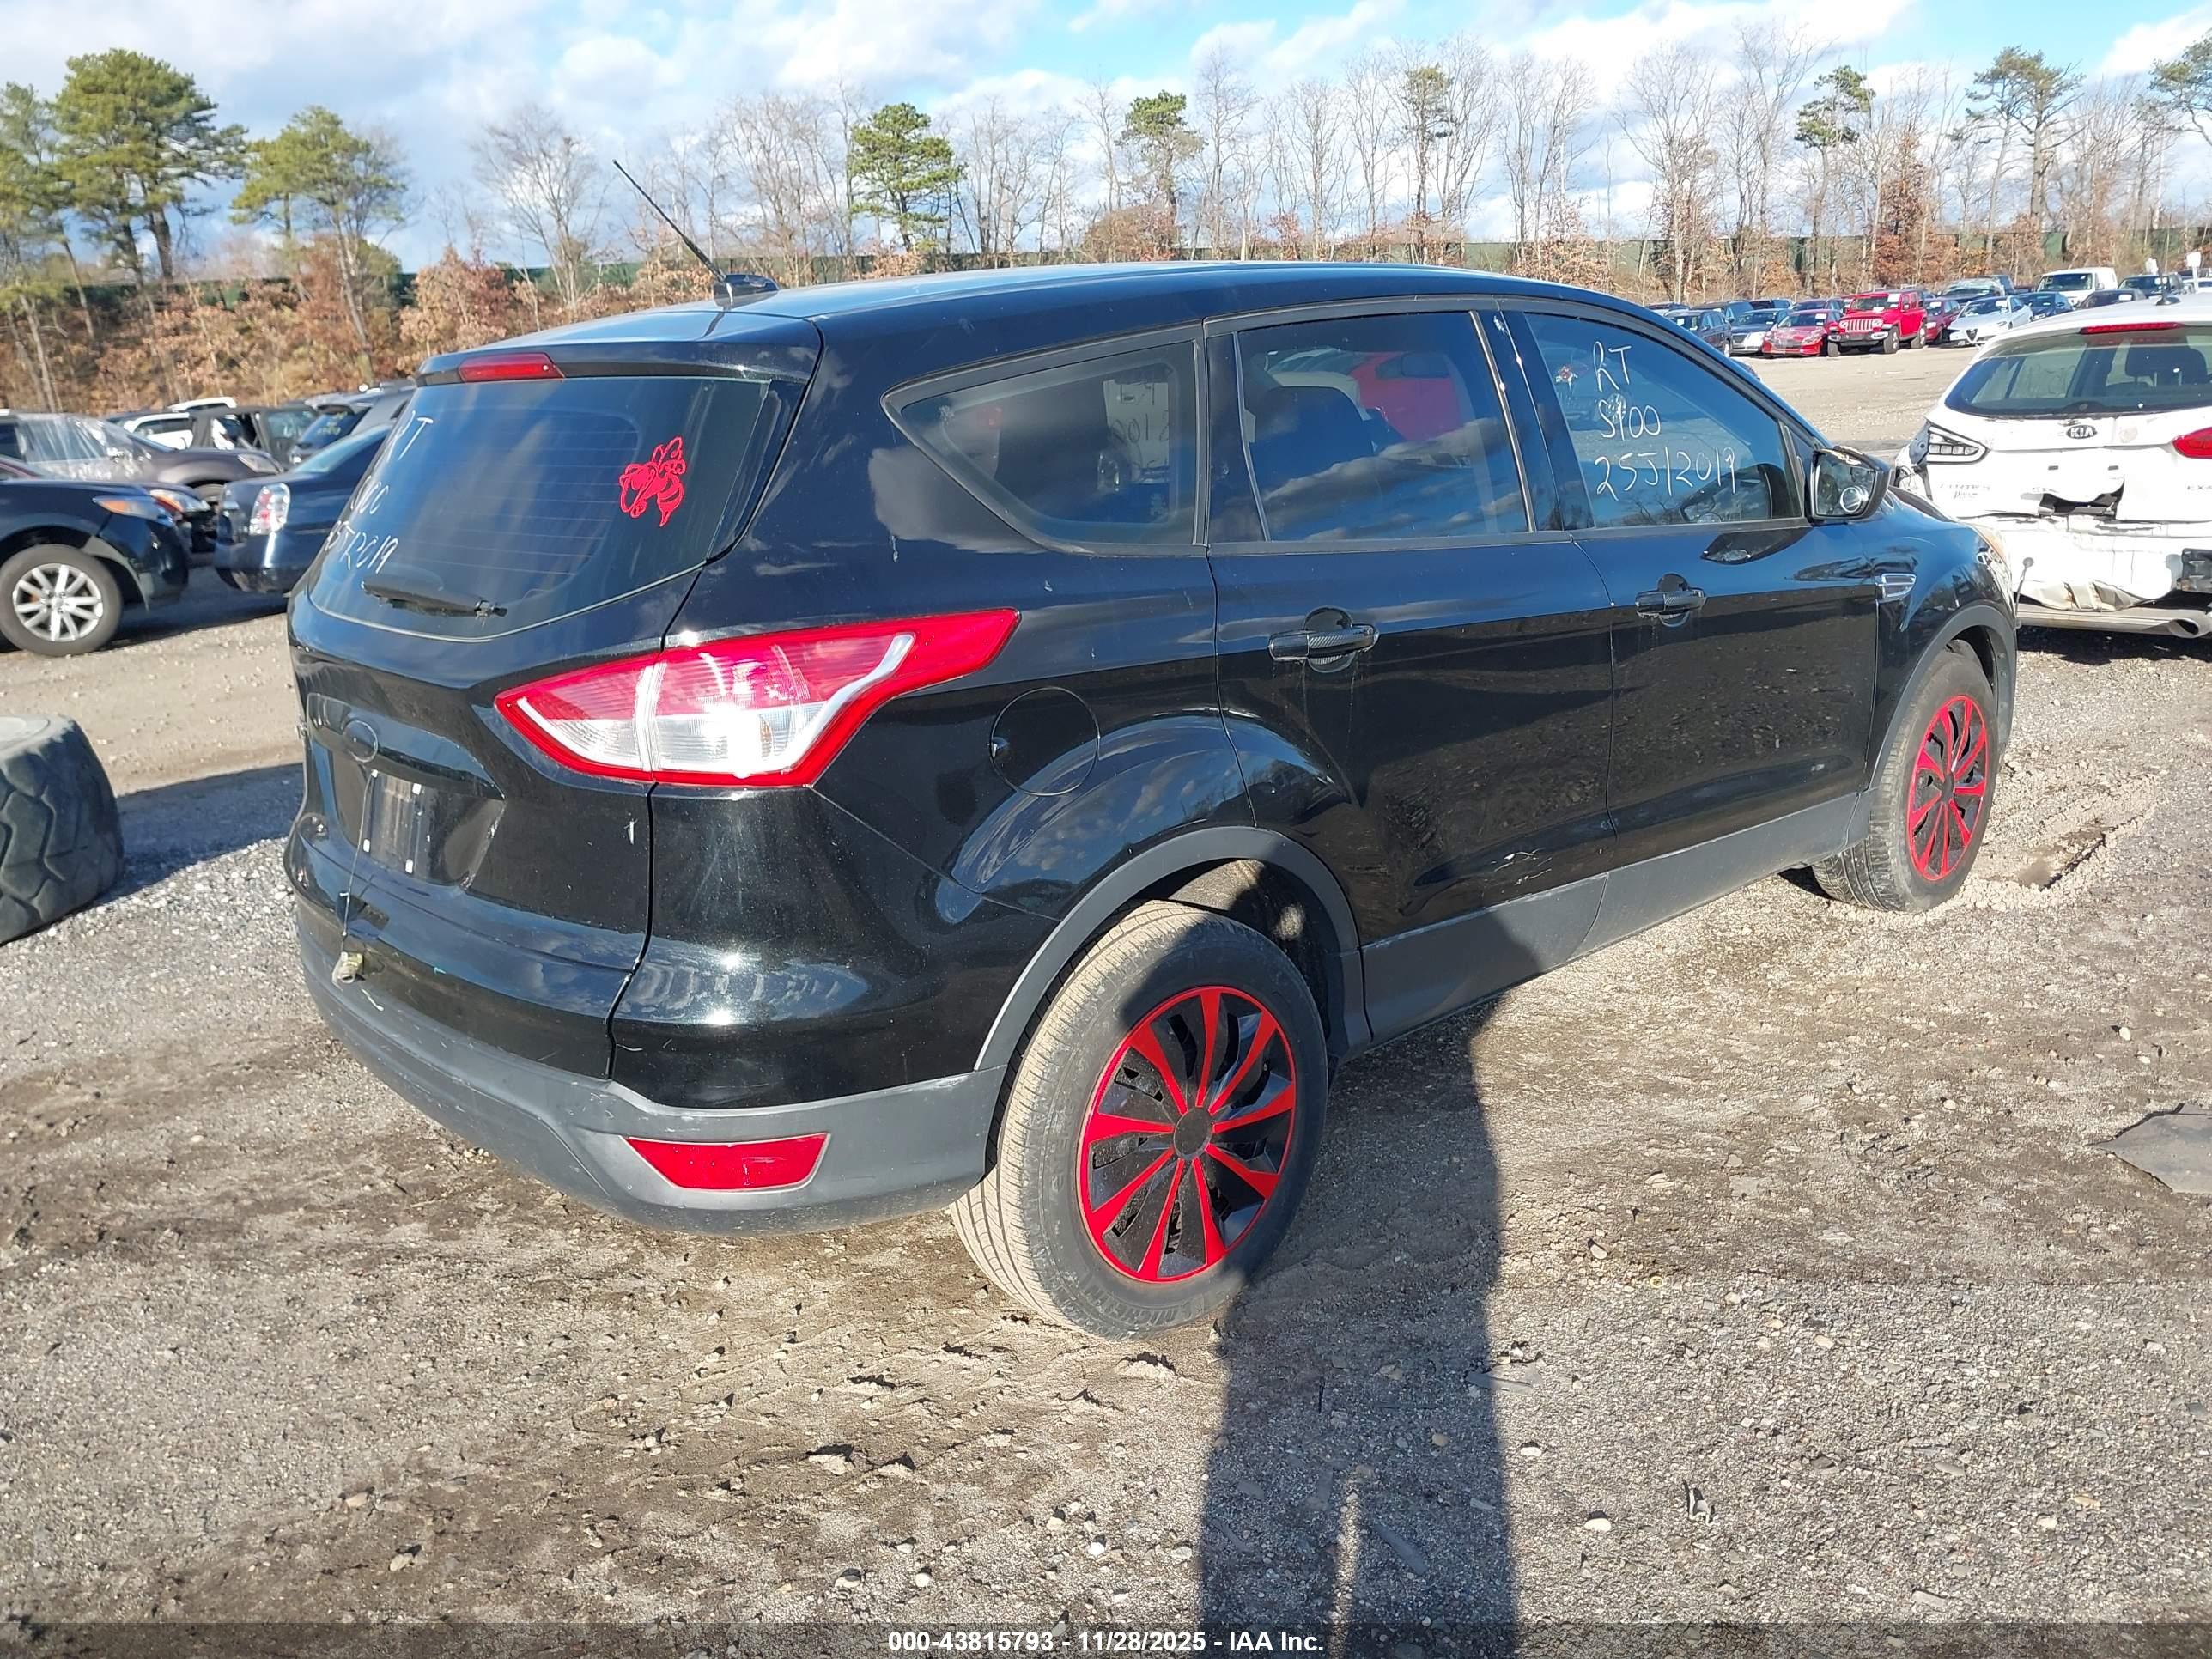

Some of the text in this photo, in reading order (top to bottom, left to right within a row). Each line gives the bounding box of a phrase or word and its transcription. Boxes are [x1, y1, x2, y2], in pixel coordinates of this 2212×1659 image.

[1593, 341, 1632, 392] RT
[1598, 398, 1662, 441] S100
[2069, 427, 2095, 438] KIA
